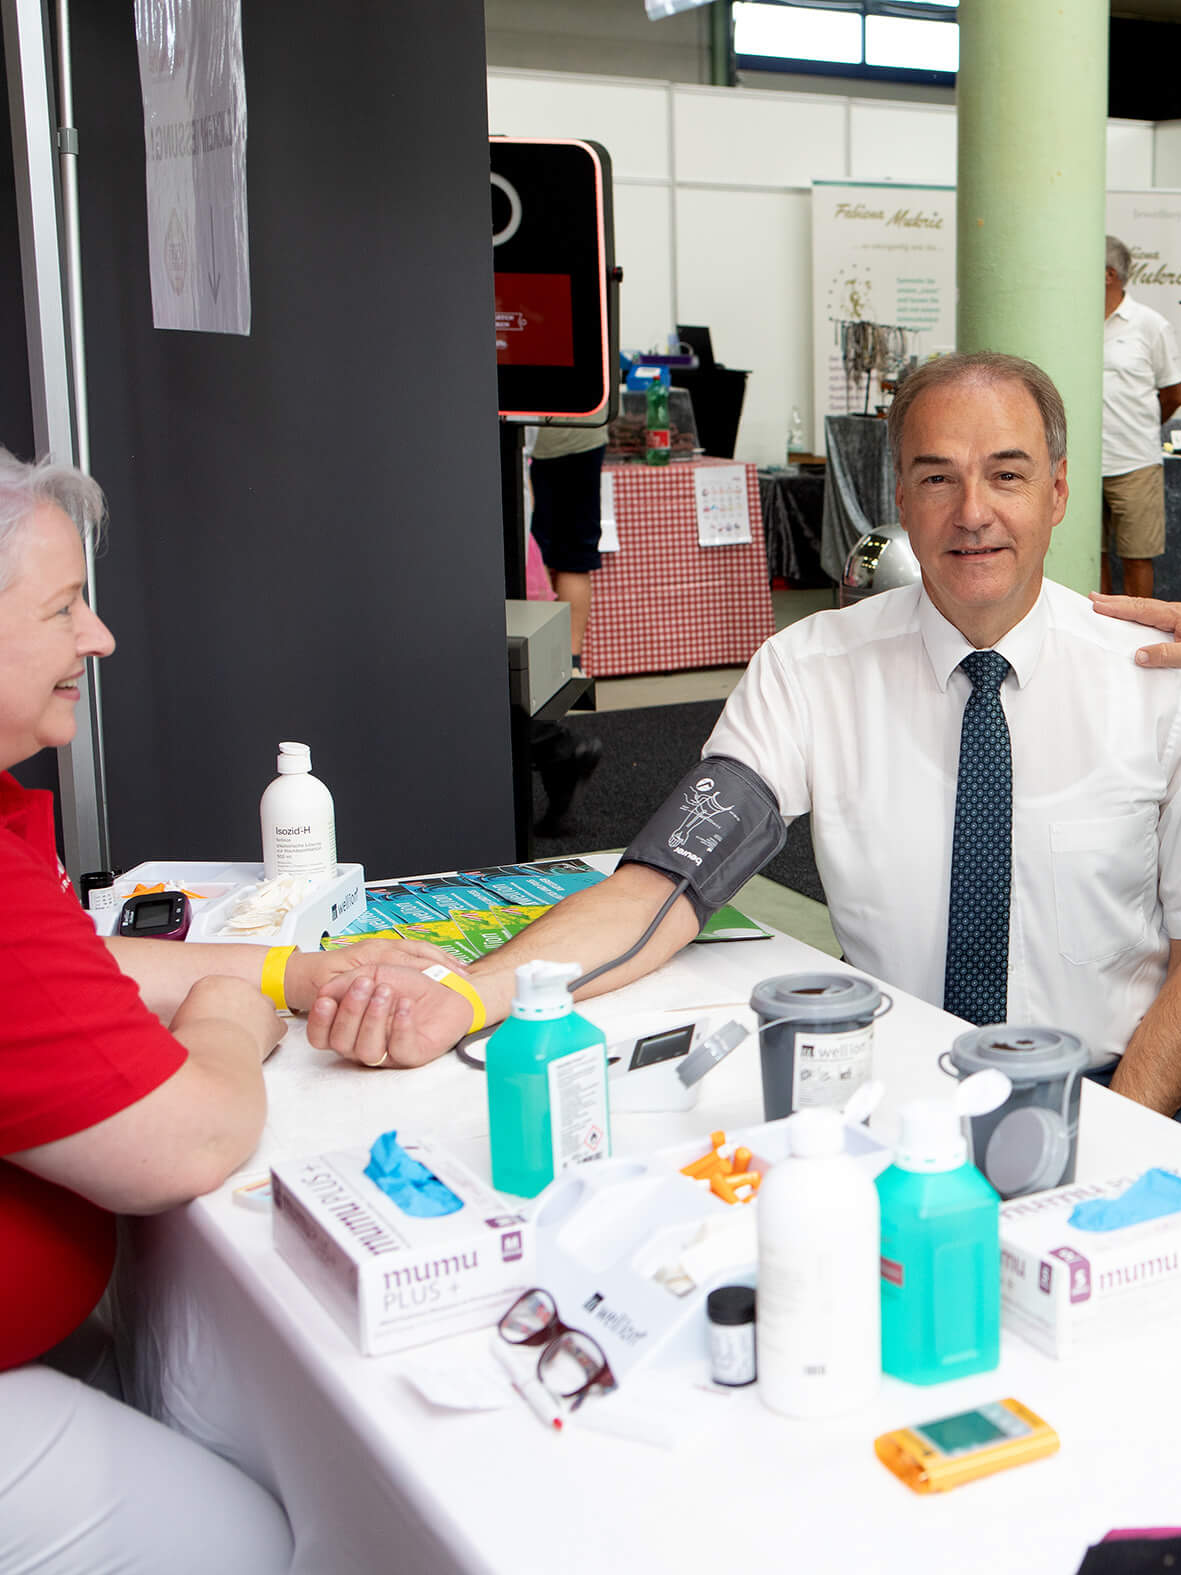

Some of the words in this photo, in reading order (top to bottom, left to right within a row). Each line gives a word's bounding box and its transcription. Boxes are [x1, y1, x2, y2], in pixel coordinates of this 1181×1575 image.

[275, 825, 311, 836] Isozid-H
[673, 846, 703, 867] beurer
[328, 1202, 402, 1256] mumu
[383, 1250, 479, 1290] mumu
[1100, 1253, 1179, 1288] mumu
[384, 1282, 442, 1313] PLUS
